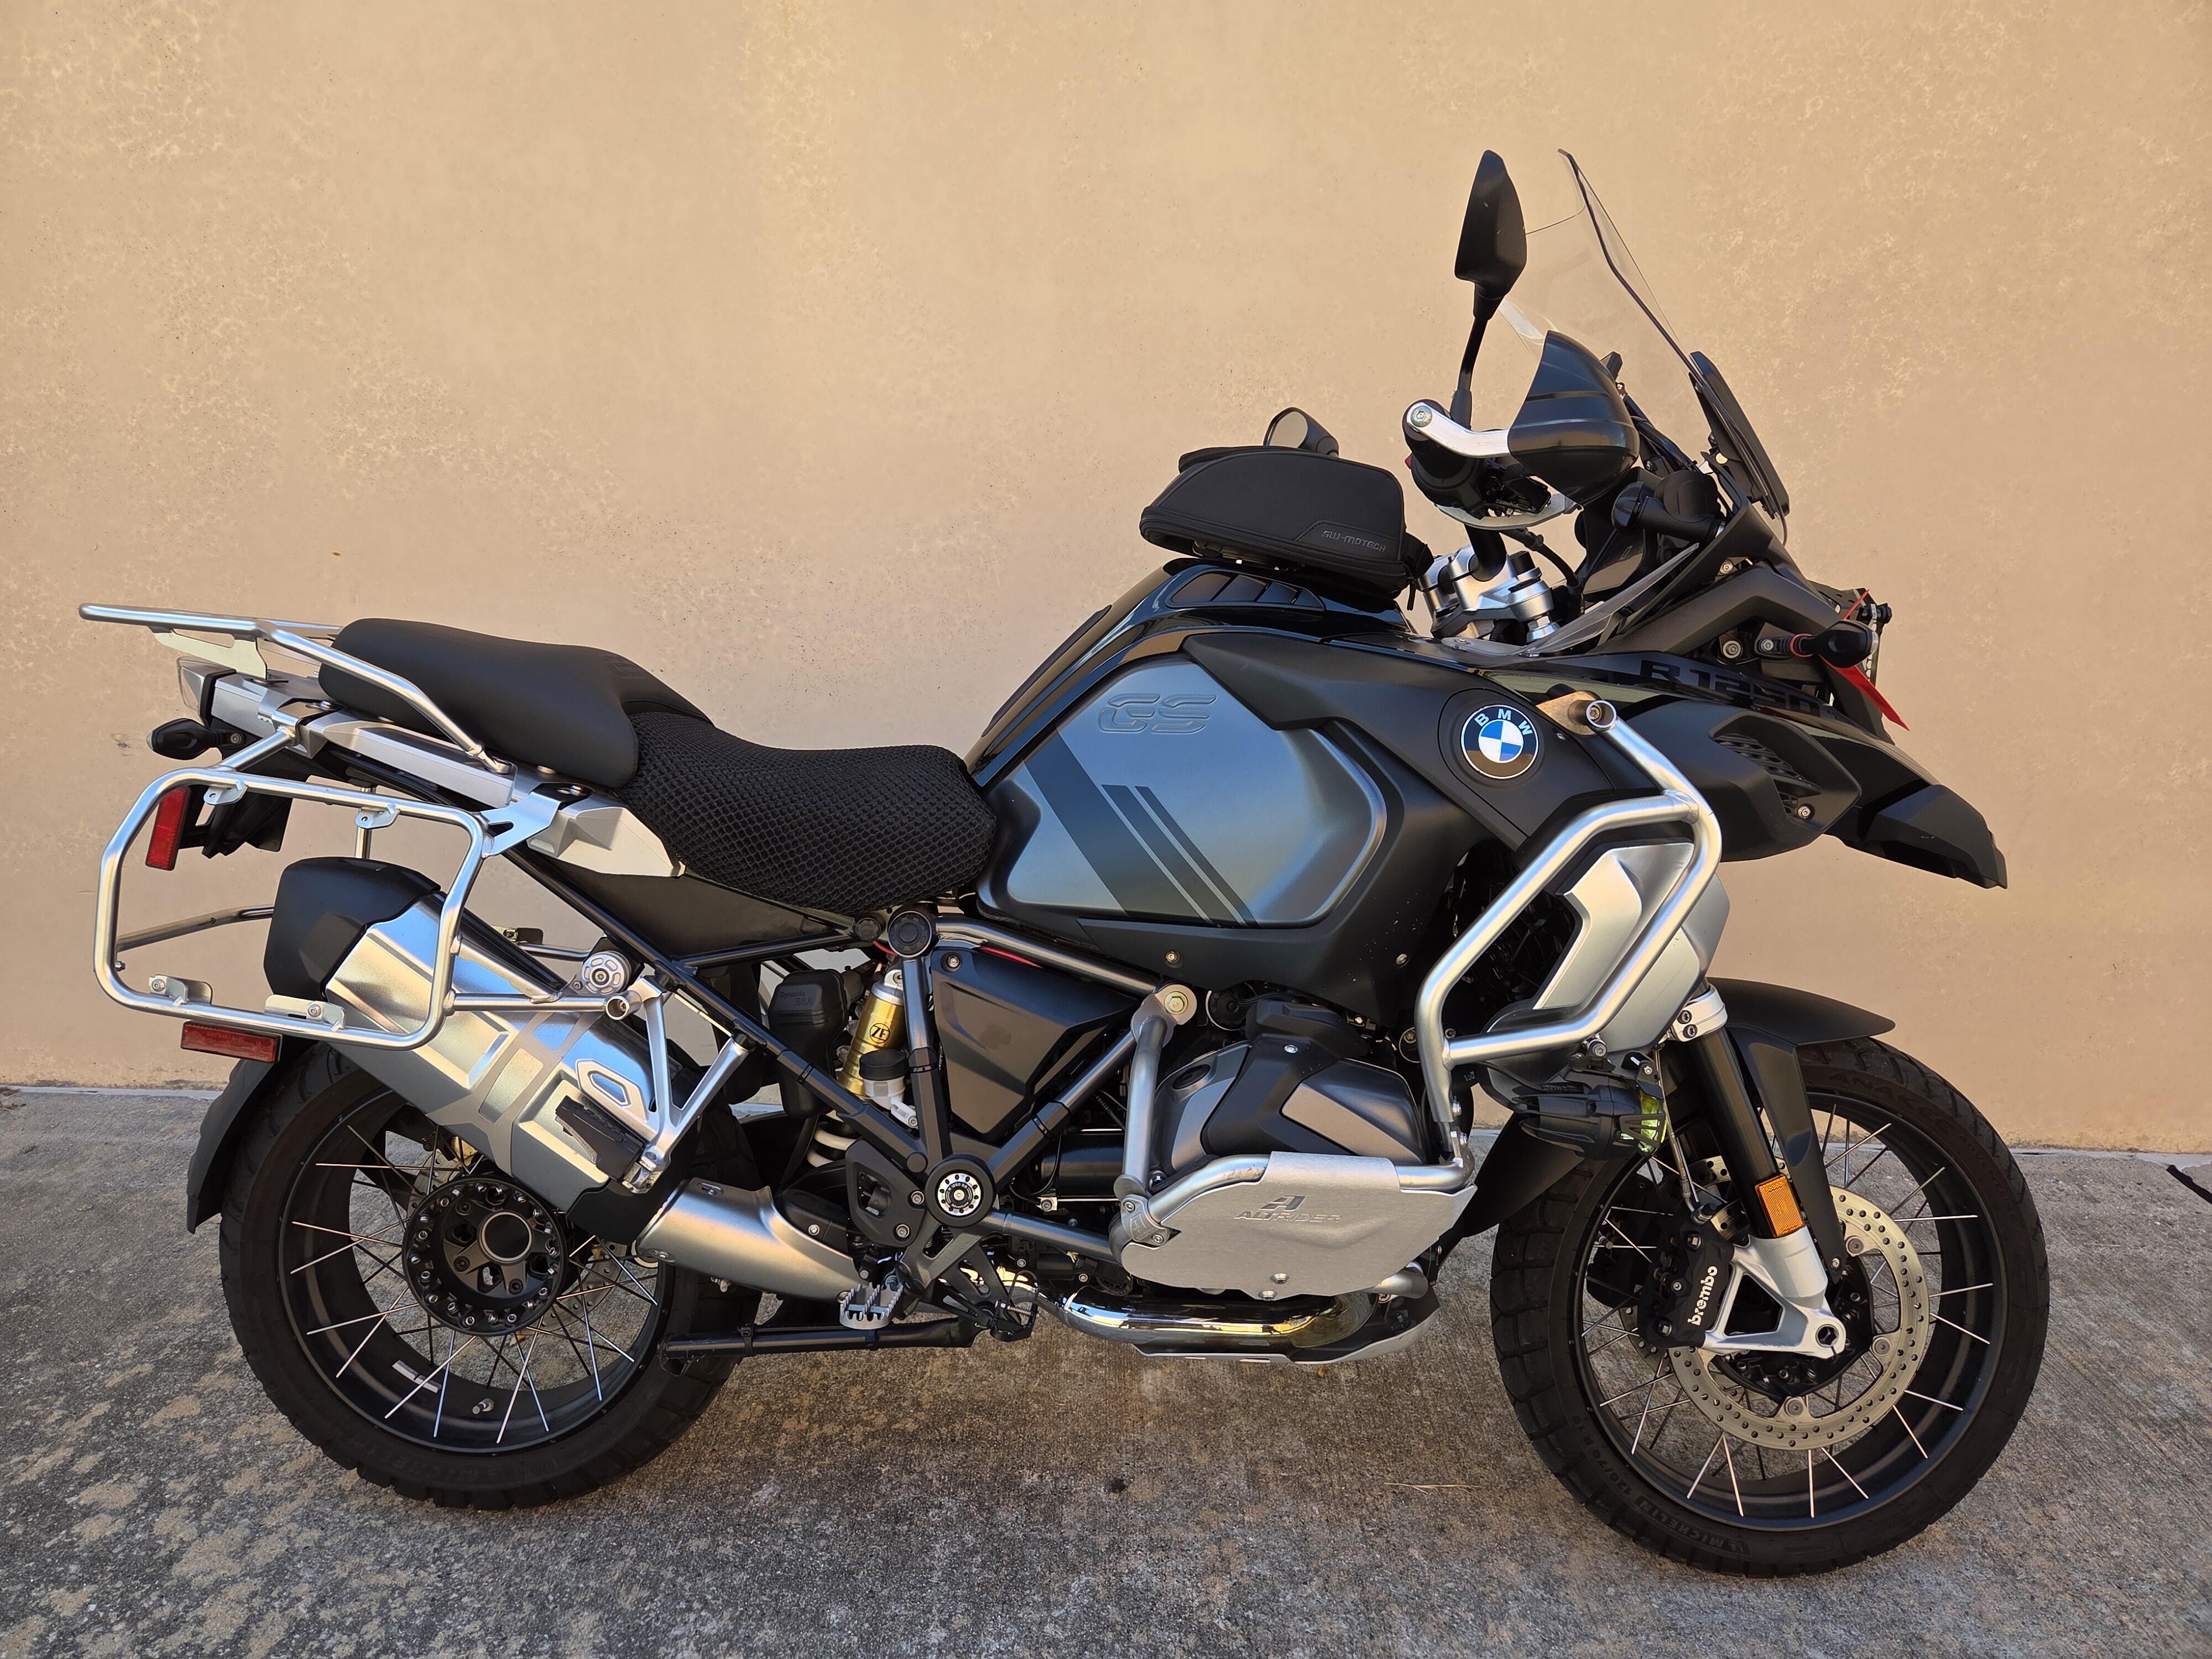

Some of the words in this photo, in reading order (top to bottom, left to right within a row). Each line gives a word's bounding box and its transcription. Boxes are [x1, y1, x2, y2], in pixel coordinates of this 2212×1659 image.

[1322, 530, 1386, 552] SW-MOTECH
[1098, 693, 1217, 734] GS
[1474, 708, 1533, 735] BMW
[870, 1025, 890, 1042] ZF
[1234, 1211, 1343, 1223] ALTRIDER
[1687, 1266, 1718, 1326] brembo
[1592, 1449, 1632, 1496] 120/70
[1639, 1500, 1725, 1549] MICHELIN
